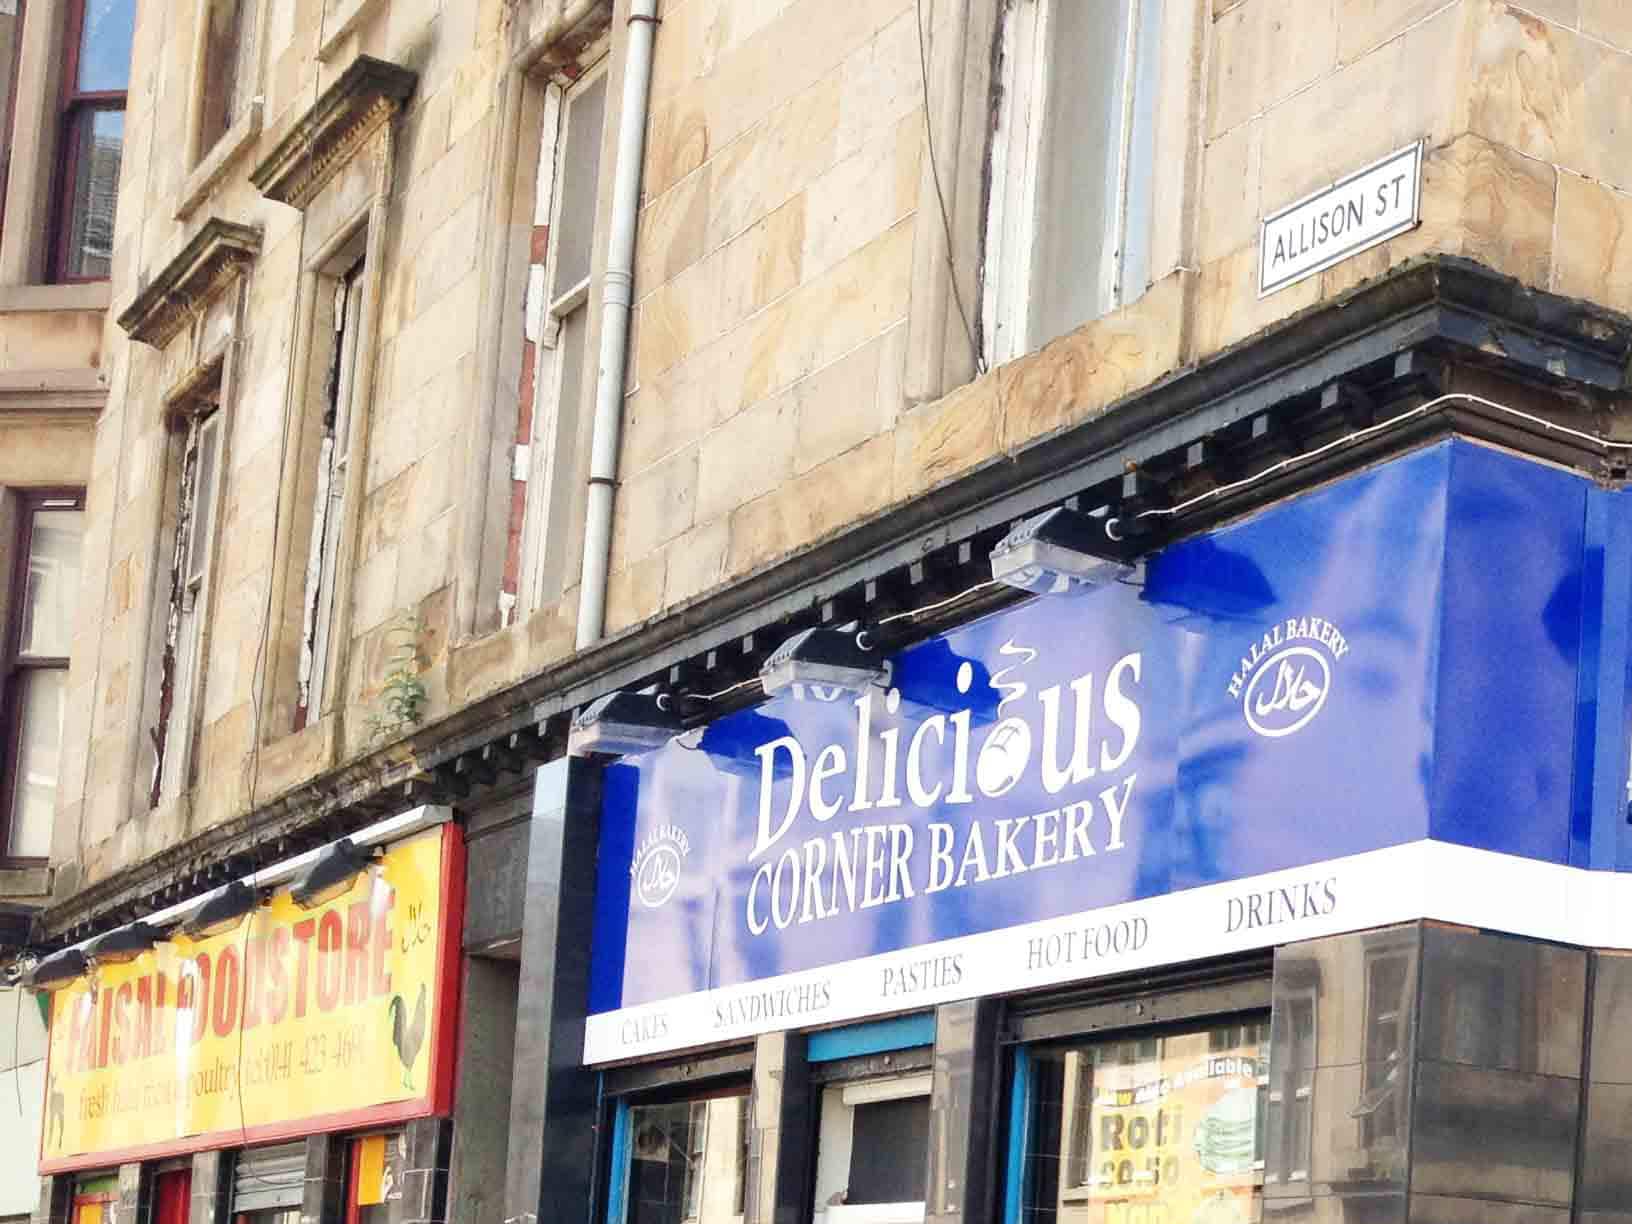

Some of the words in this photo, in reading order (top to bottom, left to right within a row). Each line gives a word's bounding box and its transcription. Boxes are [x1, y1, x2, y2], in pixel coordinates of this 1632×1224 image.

[1272, 195, 1364, 267] ALLISON
[1375, 175, 1405, 217] ST
[1227, 624, 1284, 699] HALAL
[1286, 616, 1349, 661] BAKERY
[748, 652, 1141, 862] Delicious
[746, 822, 915, 936] CORNER
[925, 773, 1137, 895] BAKERY
[1224, 877, 1337, 934] DRINKS
[1027, 931, 1077, 970] HOT
[1083, 917, 1148, 959] FOOD
[881, 954, 964, 997] PASTIES
[620, 1013, 668, 1045] CAKES
[713, 980, 832, 1029] SANDWICHES
